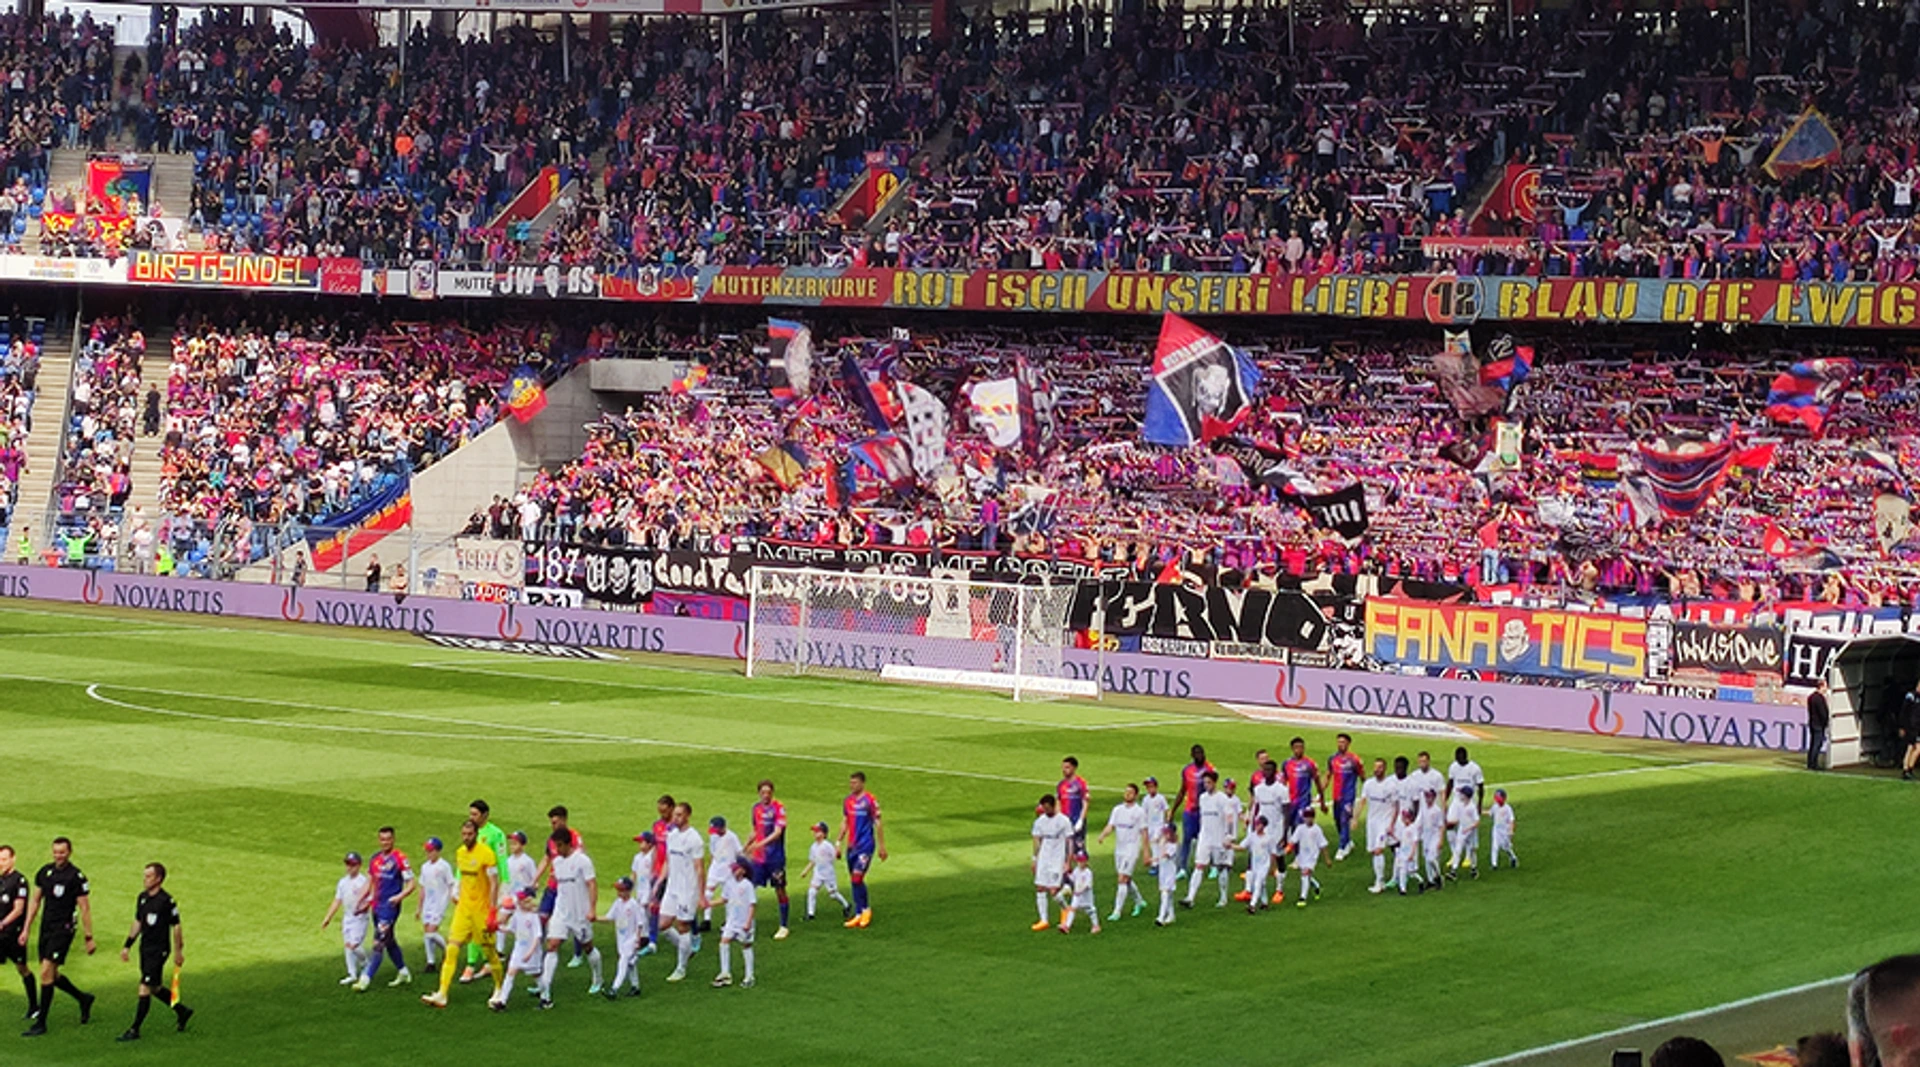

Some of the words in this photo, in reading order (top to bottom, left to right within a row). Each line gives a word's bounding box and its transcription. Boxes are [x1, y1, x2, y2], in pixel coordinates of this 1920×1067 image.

[712, 275, 877, 297] MUTTENZERKURVE
[893, 271, 969, 306] ROT
[1499, 281, 1638, 320] BLAU
[535, 546, 580, 584] 187
[113, 584, 223, 614] NOVARTIS
[315, 600, 434, 632] NOVARTIS
[535, 618, 664, 651] NOVARTIS
[1324, 682, 1495, 724] NOVARTIS
[1643, 710, 1812, 752] NOVARTI
